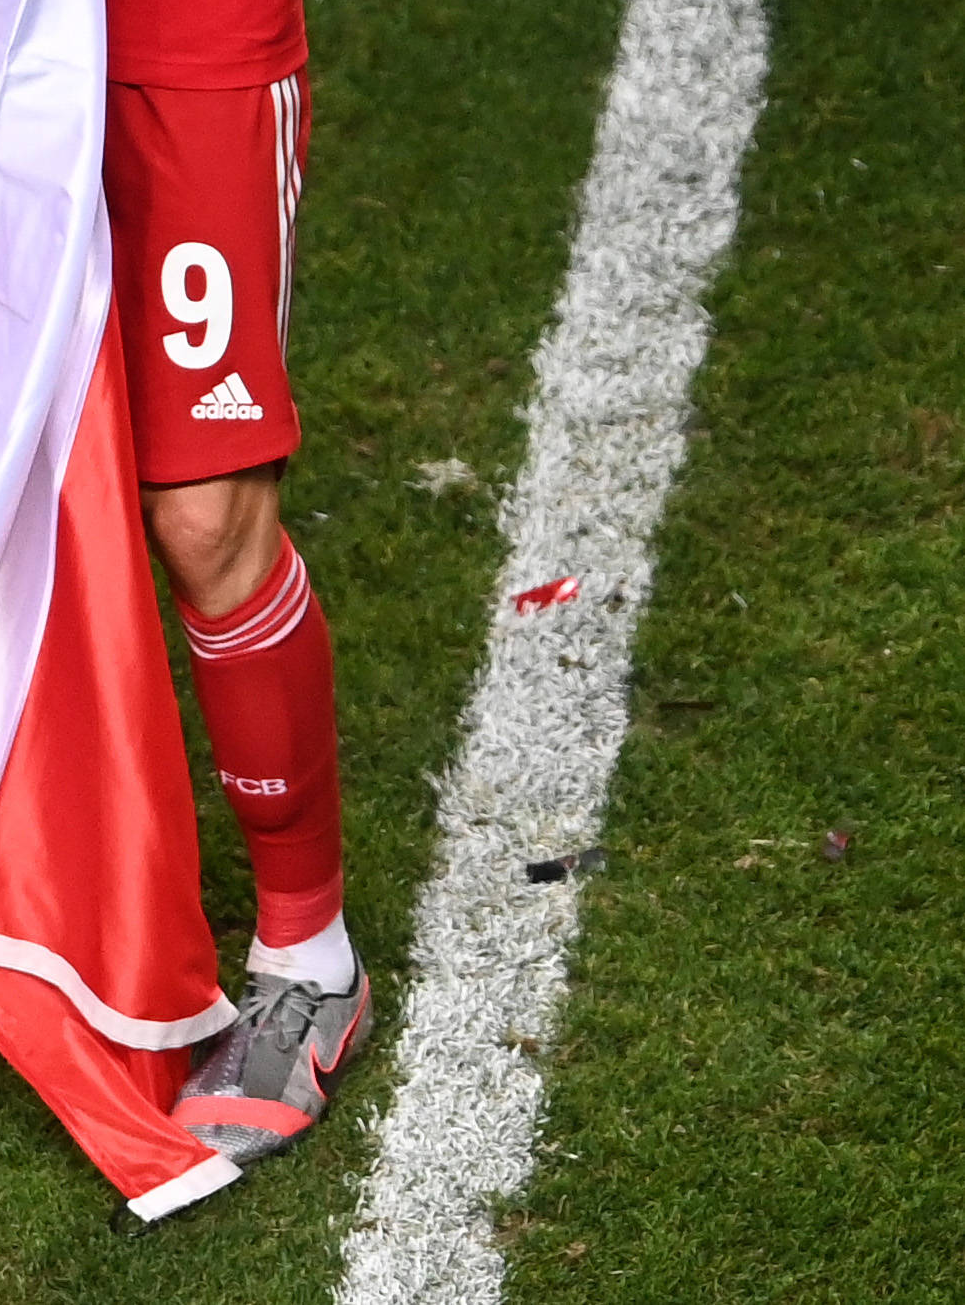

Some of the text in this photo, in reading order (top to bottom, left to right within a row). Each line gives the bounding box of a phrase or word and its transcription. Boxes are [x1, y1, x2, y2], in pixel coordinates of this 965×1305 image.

[160, 241, 234, 370] 9
[190, 403, 264, 421] adidas
[219, 769, 288, 796] FCB
